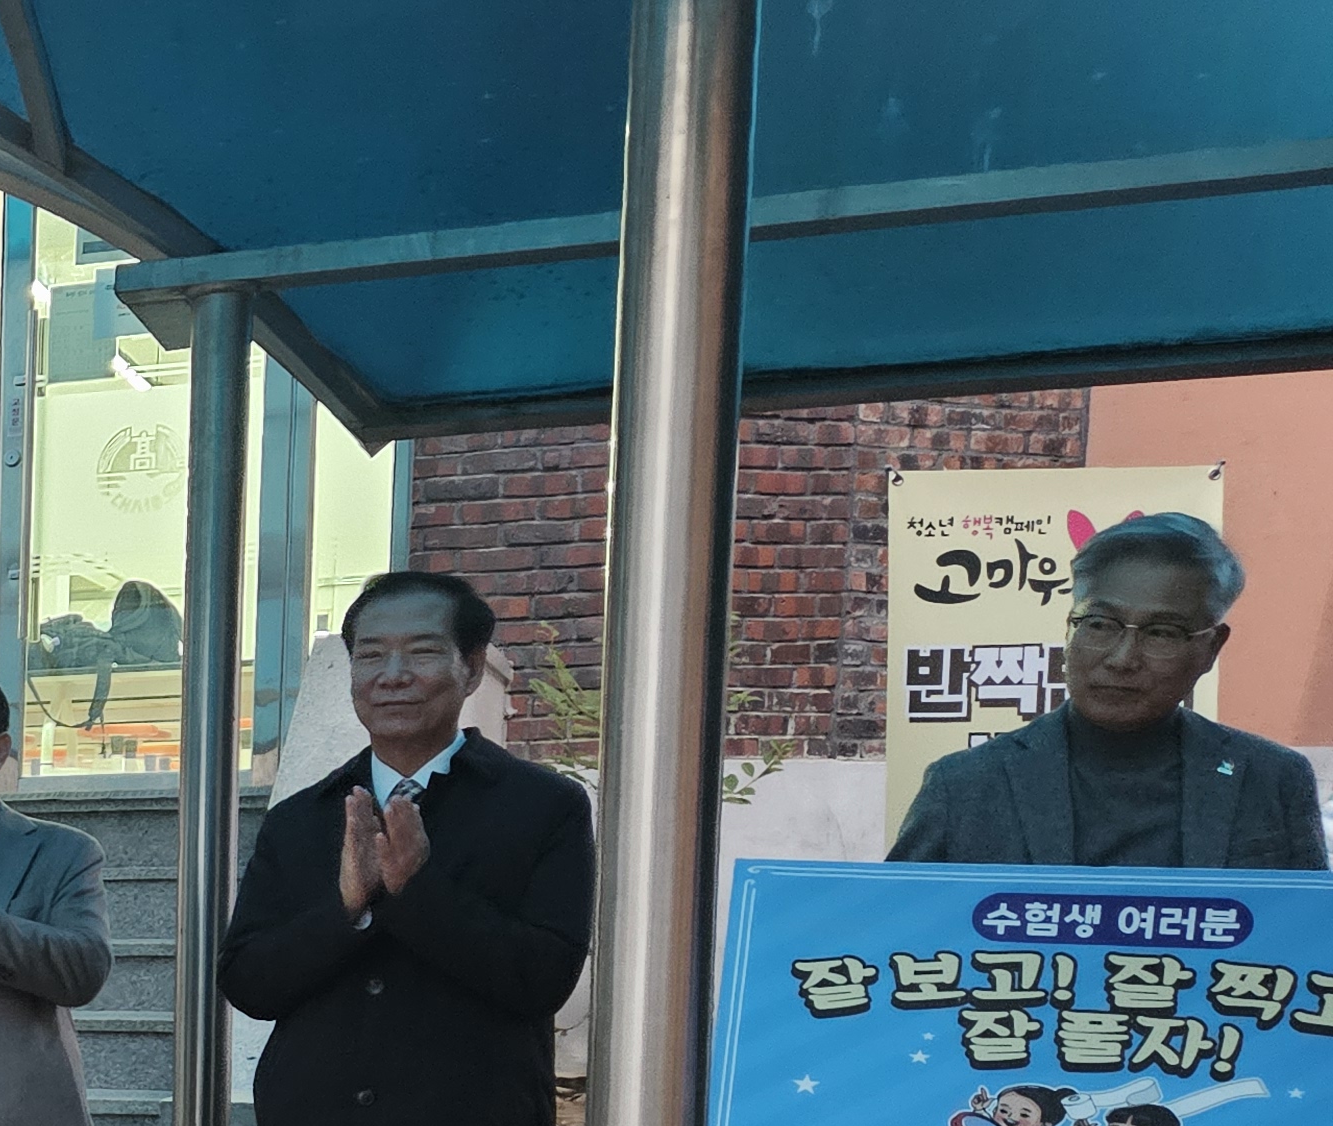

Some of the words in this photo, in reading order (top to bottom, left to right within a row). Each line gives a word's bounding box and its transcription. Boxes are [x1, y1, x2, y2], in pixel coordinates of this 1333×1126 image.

[907, 516, 954, 537] 청소년
[982, 902, 1102, 938] 수험생
[1118, 906, 1241, 943] 여러분
[793, 957, 876, 1016] 잘
[889, 952, 1077, 1008] 보고!
[1106, 954, 1194, 1013] 잘
[960, 1008, 1041, 1067] 잘
[1057, 1009, 1243, 1078] 풀자!
